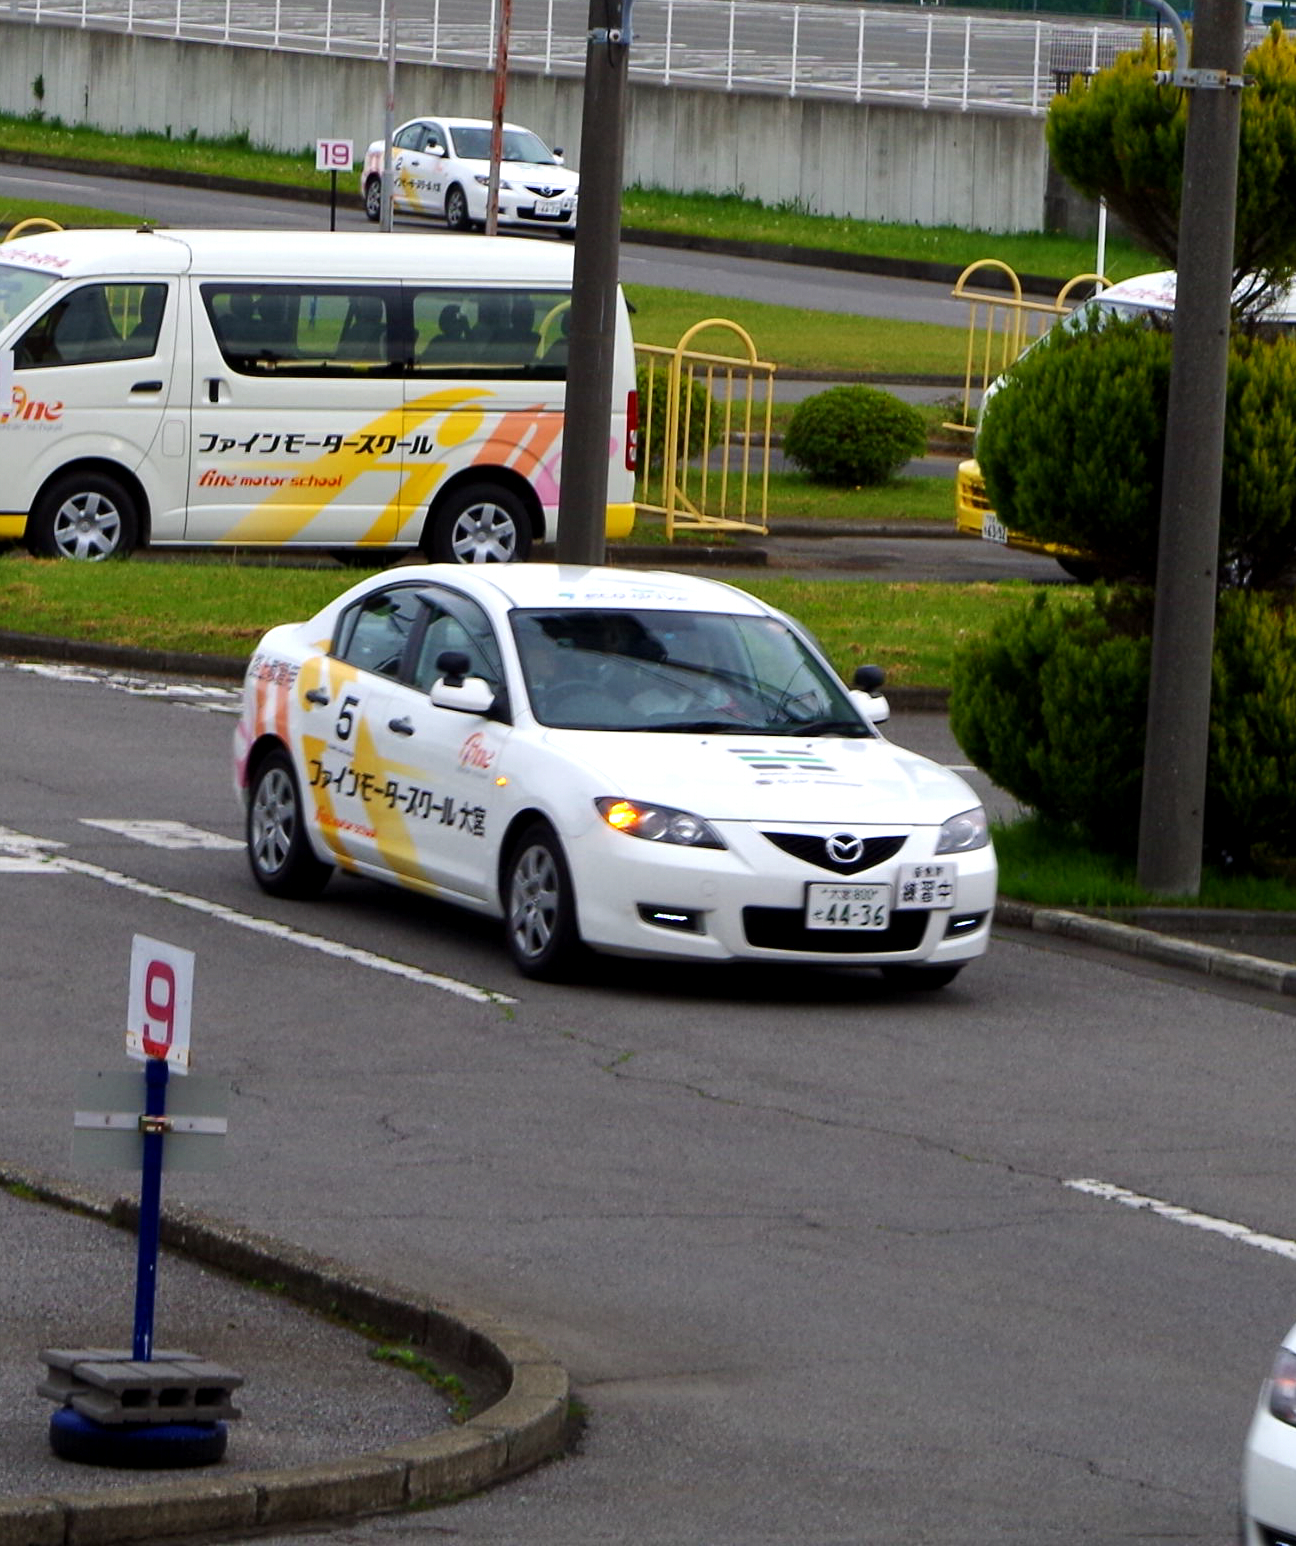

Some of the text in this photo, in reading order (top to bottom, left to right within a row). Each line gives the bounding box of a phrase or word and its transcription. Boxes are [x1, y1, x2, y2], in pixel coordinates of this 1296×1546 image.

[321, 143, 349, 165] 19
[395, 156, 404, 171] 2
[199, 433, 433, 455] ファインモータースクール
[198, 469, 342, 487] fine motor school
[336, 694, 361, 741] 5
[310, 760, 487, 838] ファインモータースクール 大宮
[826, 904, 885, 926] 44-36
[143, 959, 176, 1059] 9
